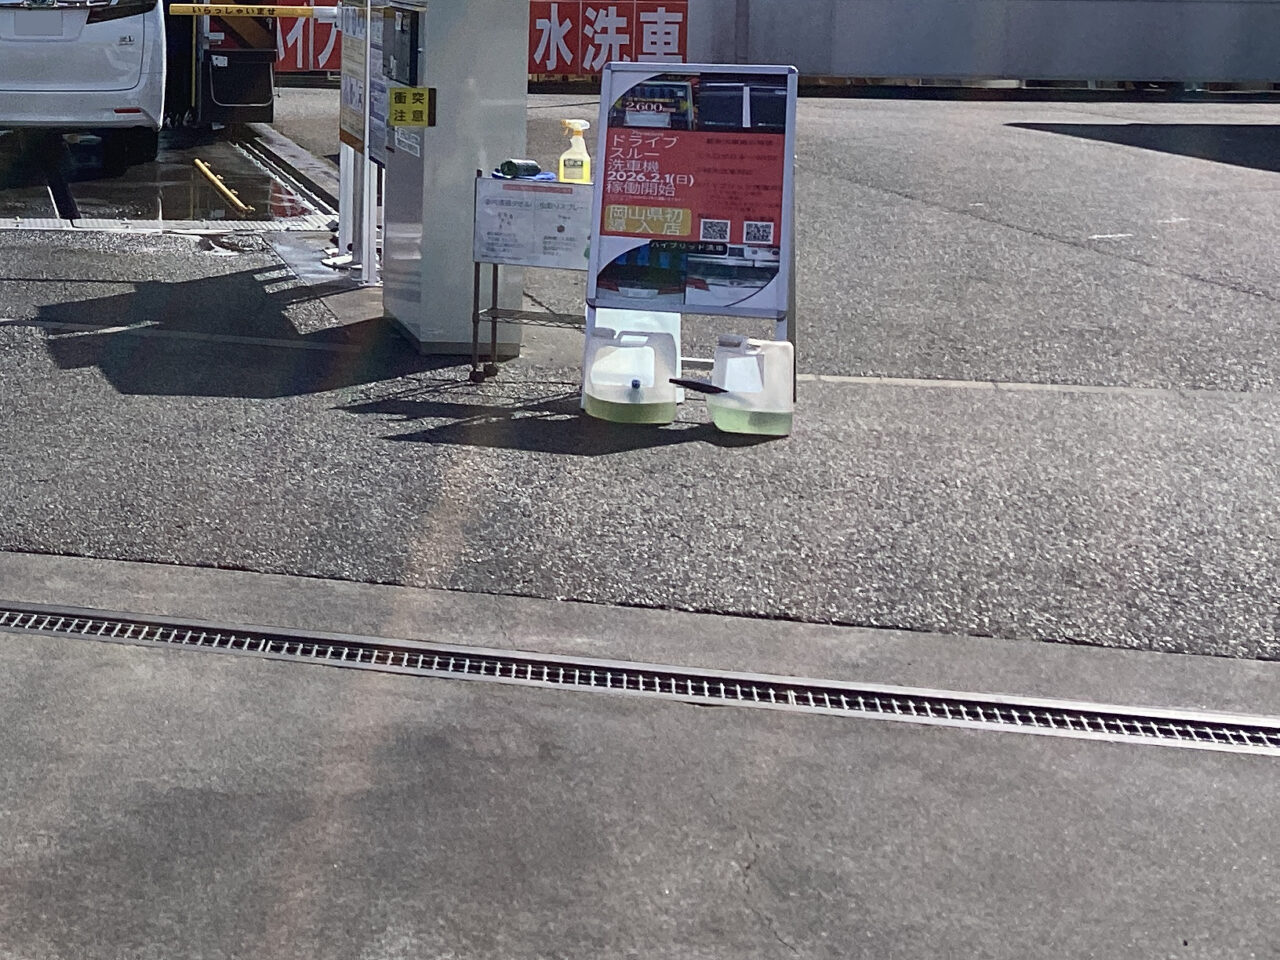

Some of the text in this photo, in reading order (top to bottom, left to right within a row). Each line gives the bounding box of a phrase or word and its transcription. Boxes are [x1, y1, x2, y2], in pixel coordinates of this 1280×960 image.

[192, 6, 276, 16] いらっしゃいませ
[394, 91, 425, 105] 衝突
[394, 109, 425, 123] 注意
[613, 134, 680, 149] ドライブ
[610, 147, 660, 159] スルー
[608, 159, 659, 173] 洗車機
[606, 181, 676, 197] 稼働開始
[610, 205, 683, 223] 岡山県初
